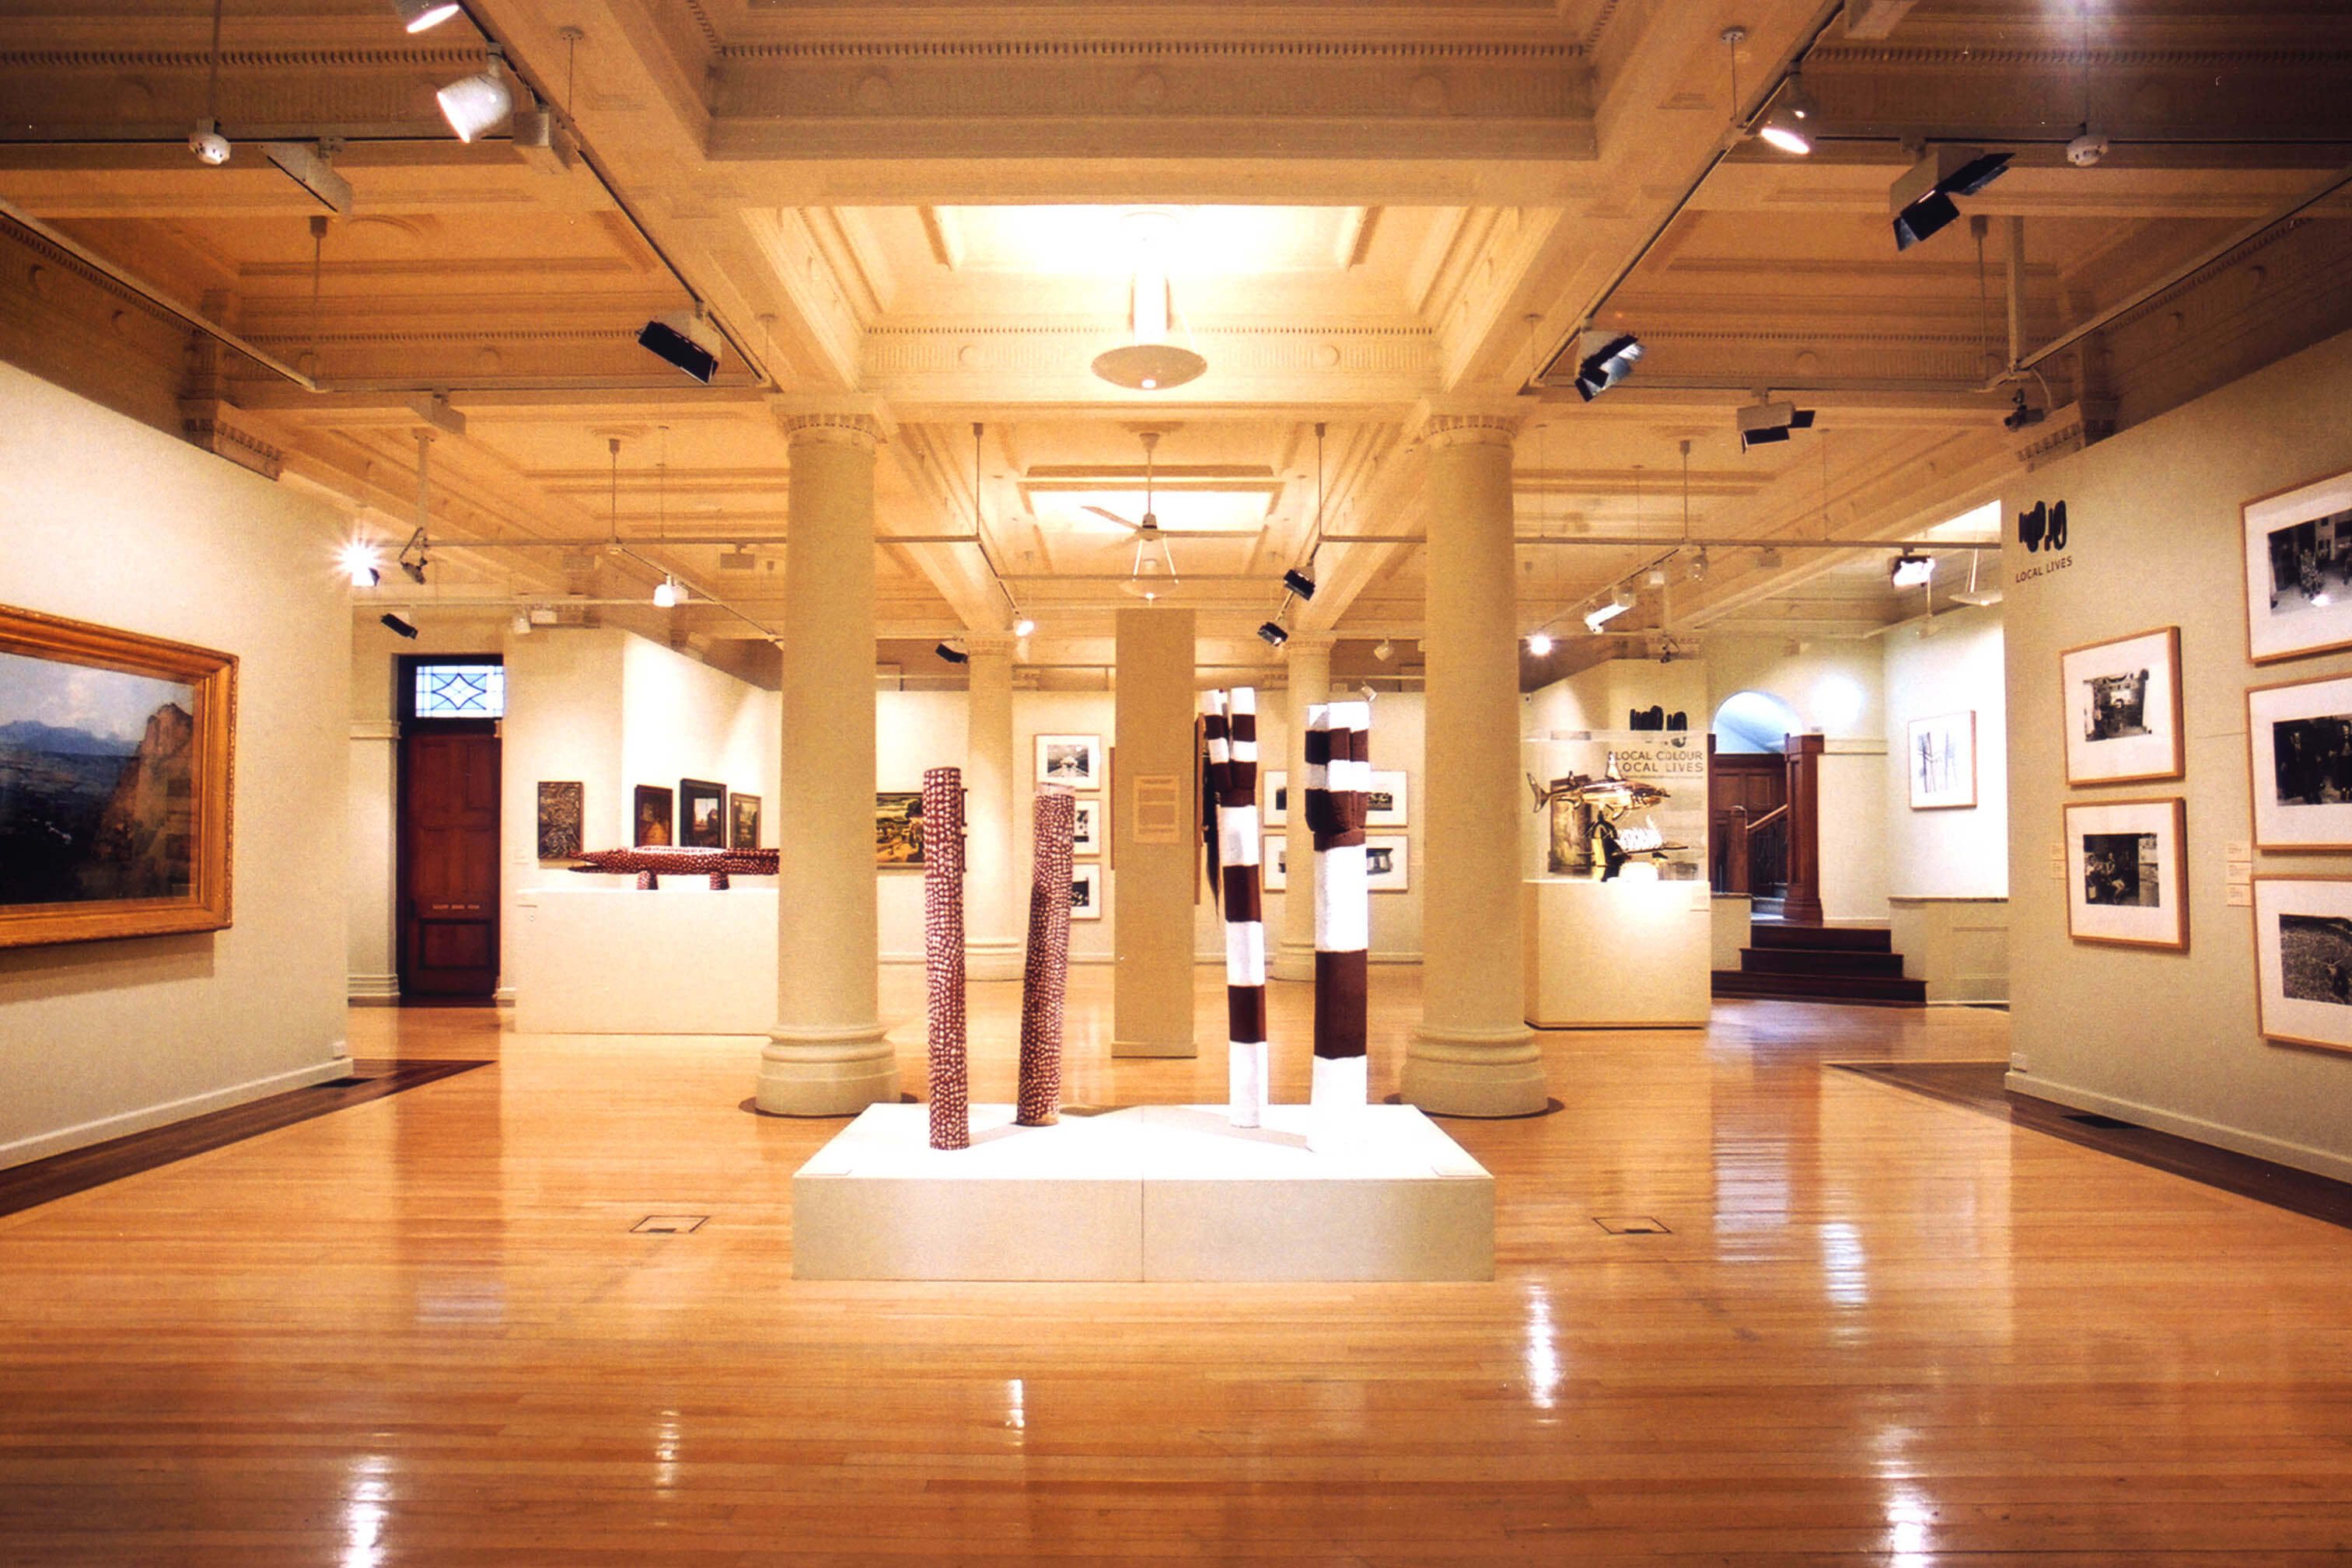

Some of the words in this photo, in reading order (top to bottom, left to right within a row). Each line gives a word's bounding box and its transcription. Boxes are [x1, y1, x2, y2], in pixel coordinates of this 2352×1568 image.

[2015, 567, 2043, 583] LOCAL
[2046, 556, 2072, 573] LIVES
[1615, 751, 1652, 760] LOCAL
[1655, 751, 1703, 760] COLOUR
[1665, 762, 1704, 772] LIVES
